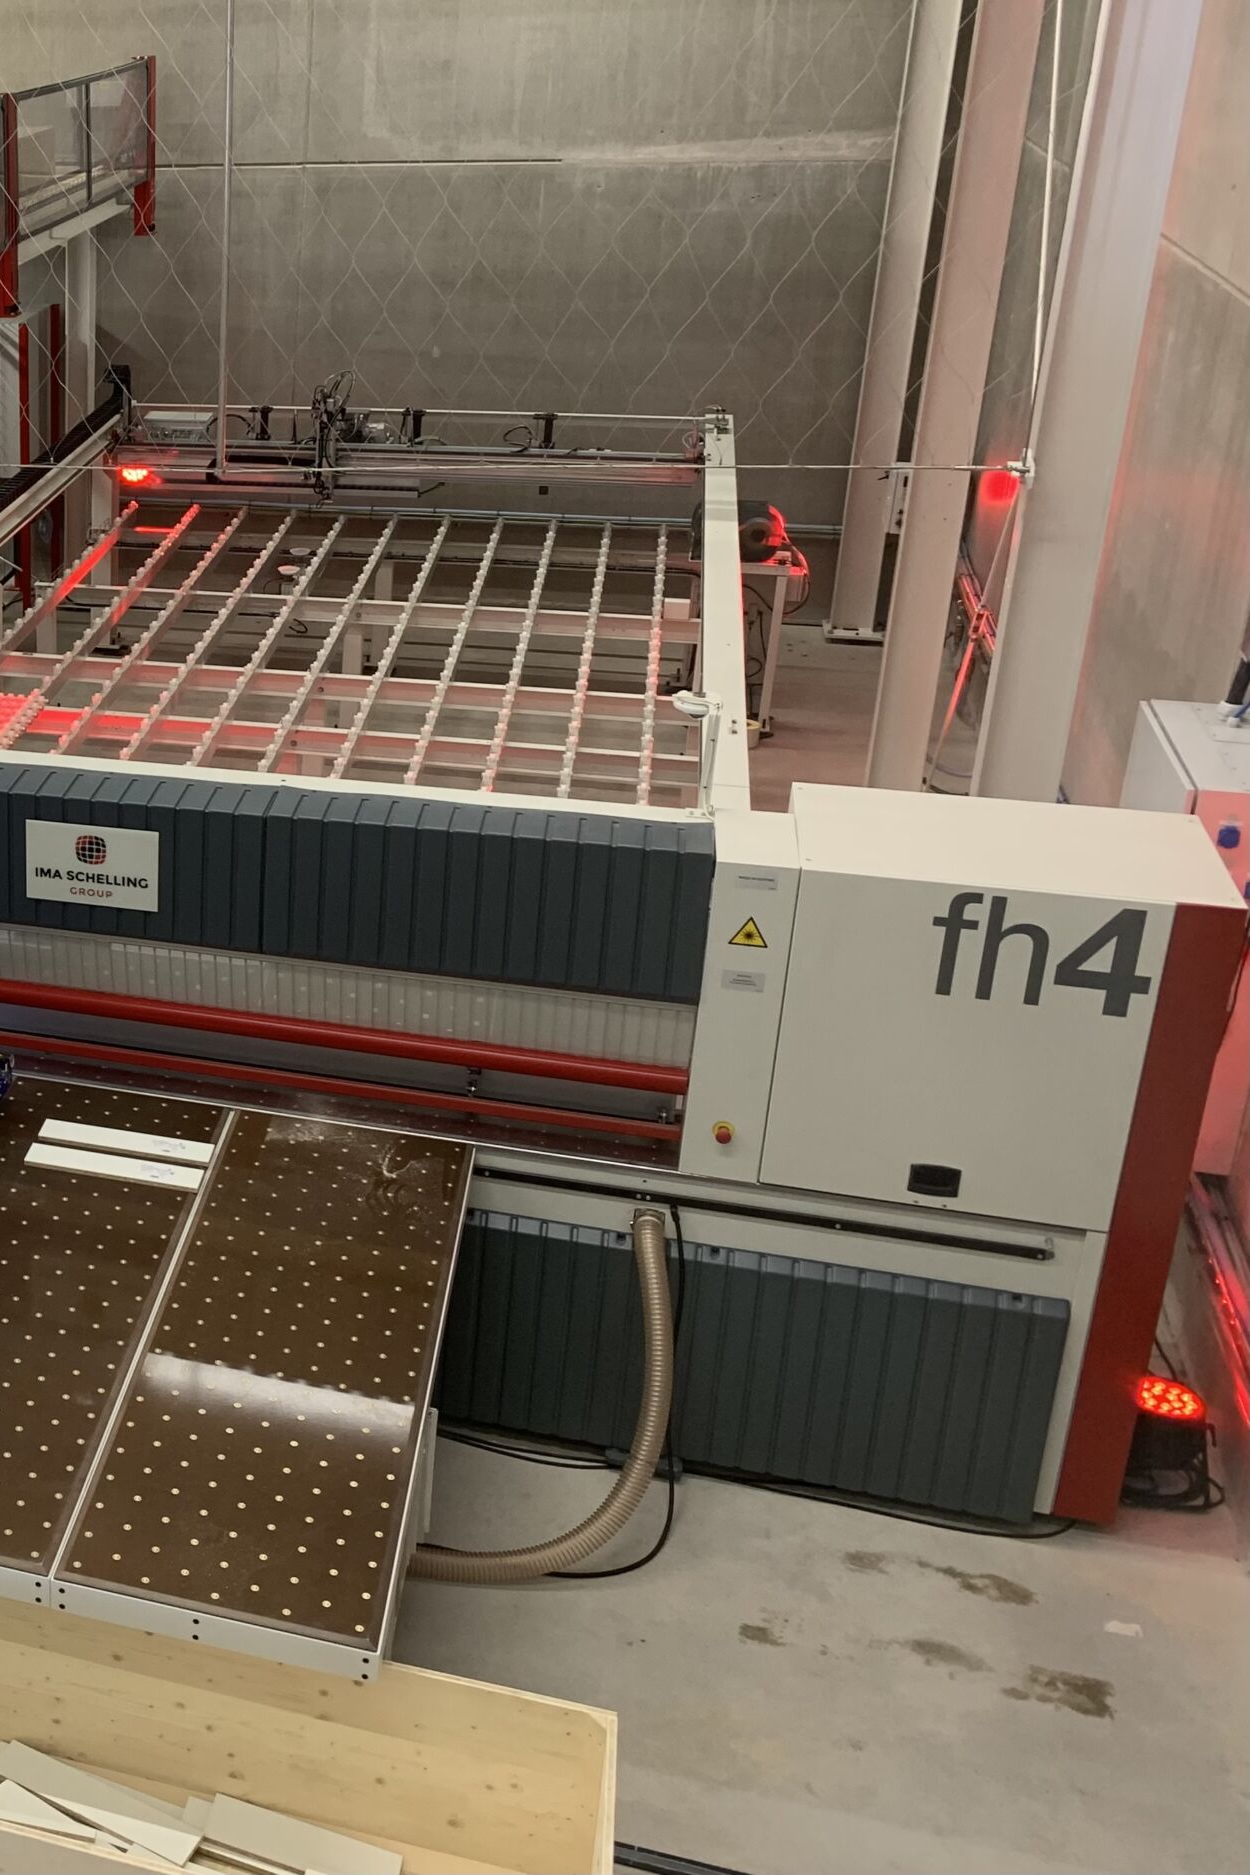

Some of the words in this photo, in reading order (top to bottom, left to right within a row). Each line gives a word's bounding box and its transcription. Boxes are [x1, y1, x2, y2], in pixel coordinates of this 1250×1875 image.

[35, 866, 63, 881] IMA
[66, 870, 149, 889] SCHELLING
[70, 886, 113, 898] GROUP
[932, 892, 1152, 1018] fh4
